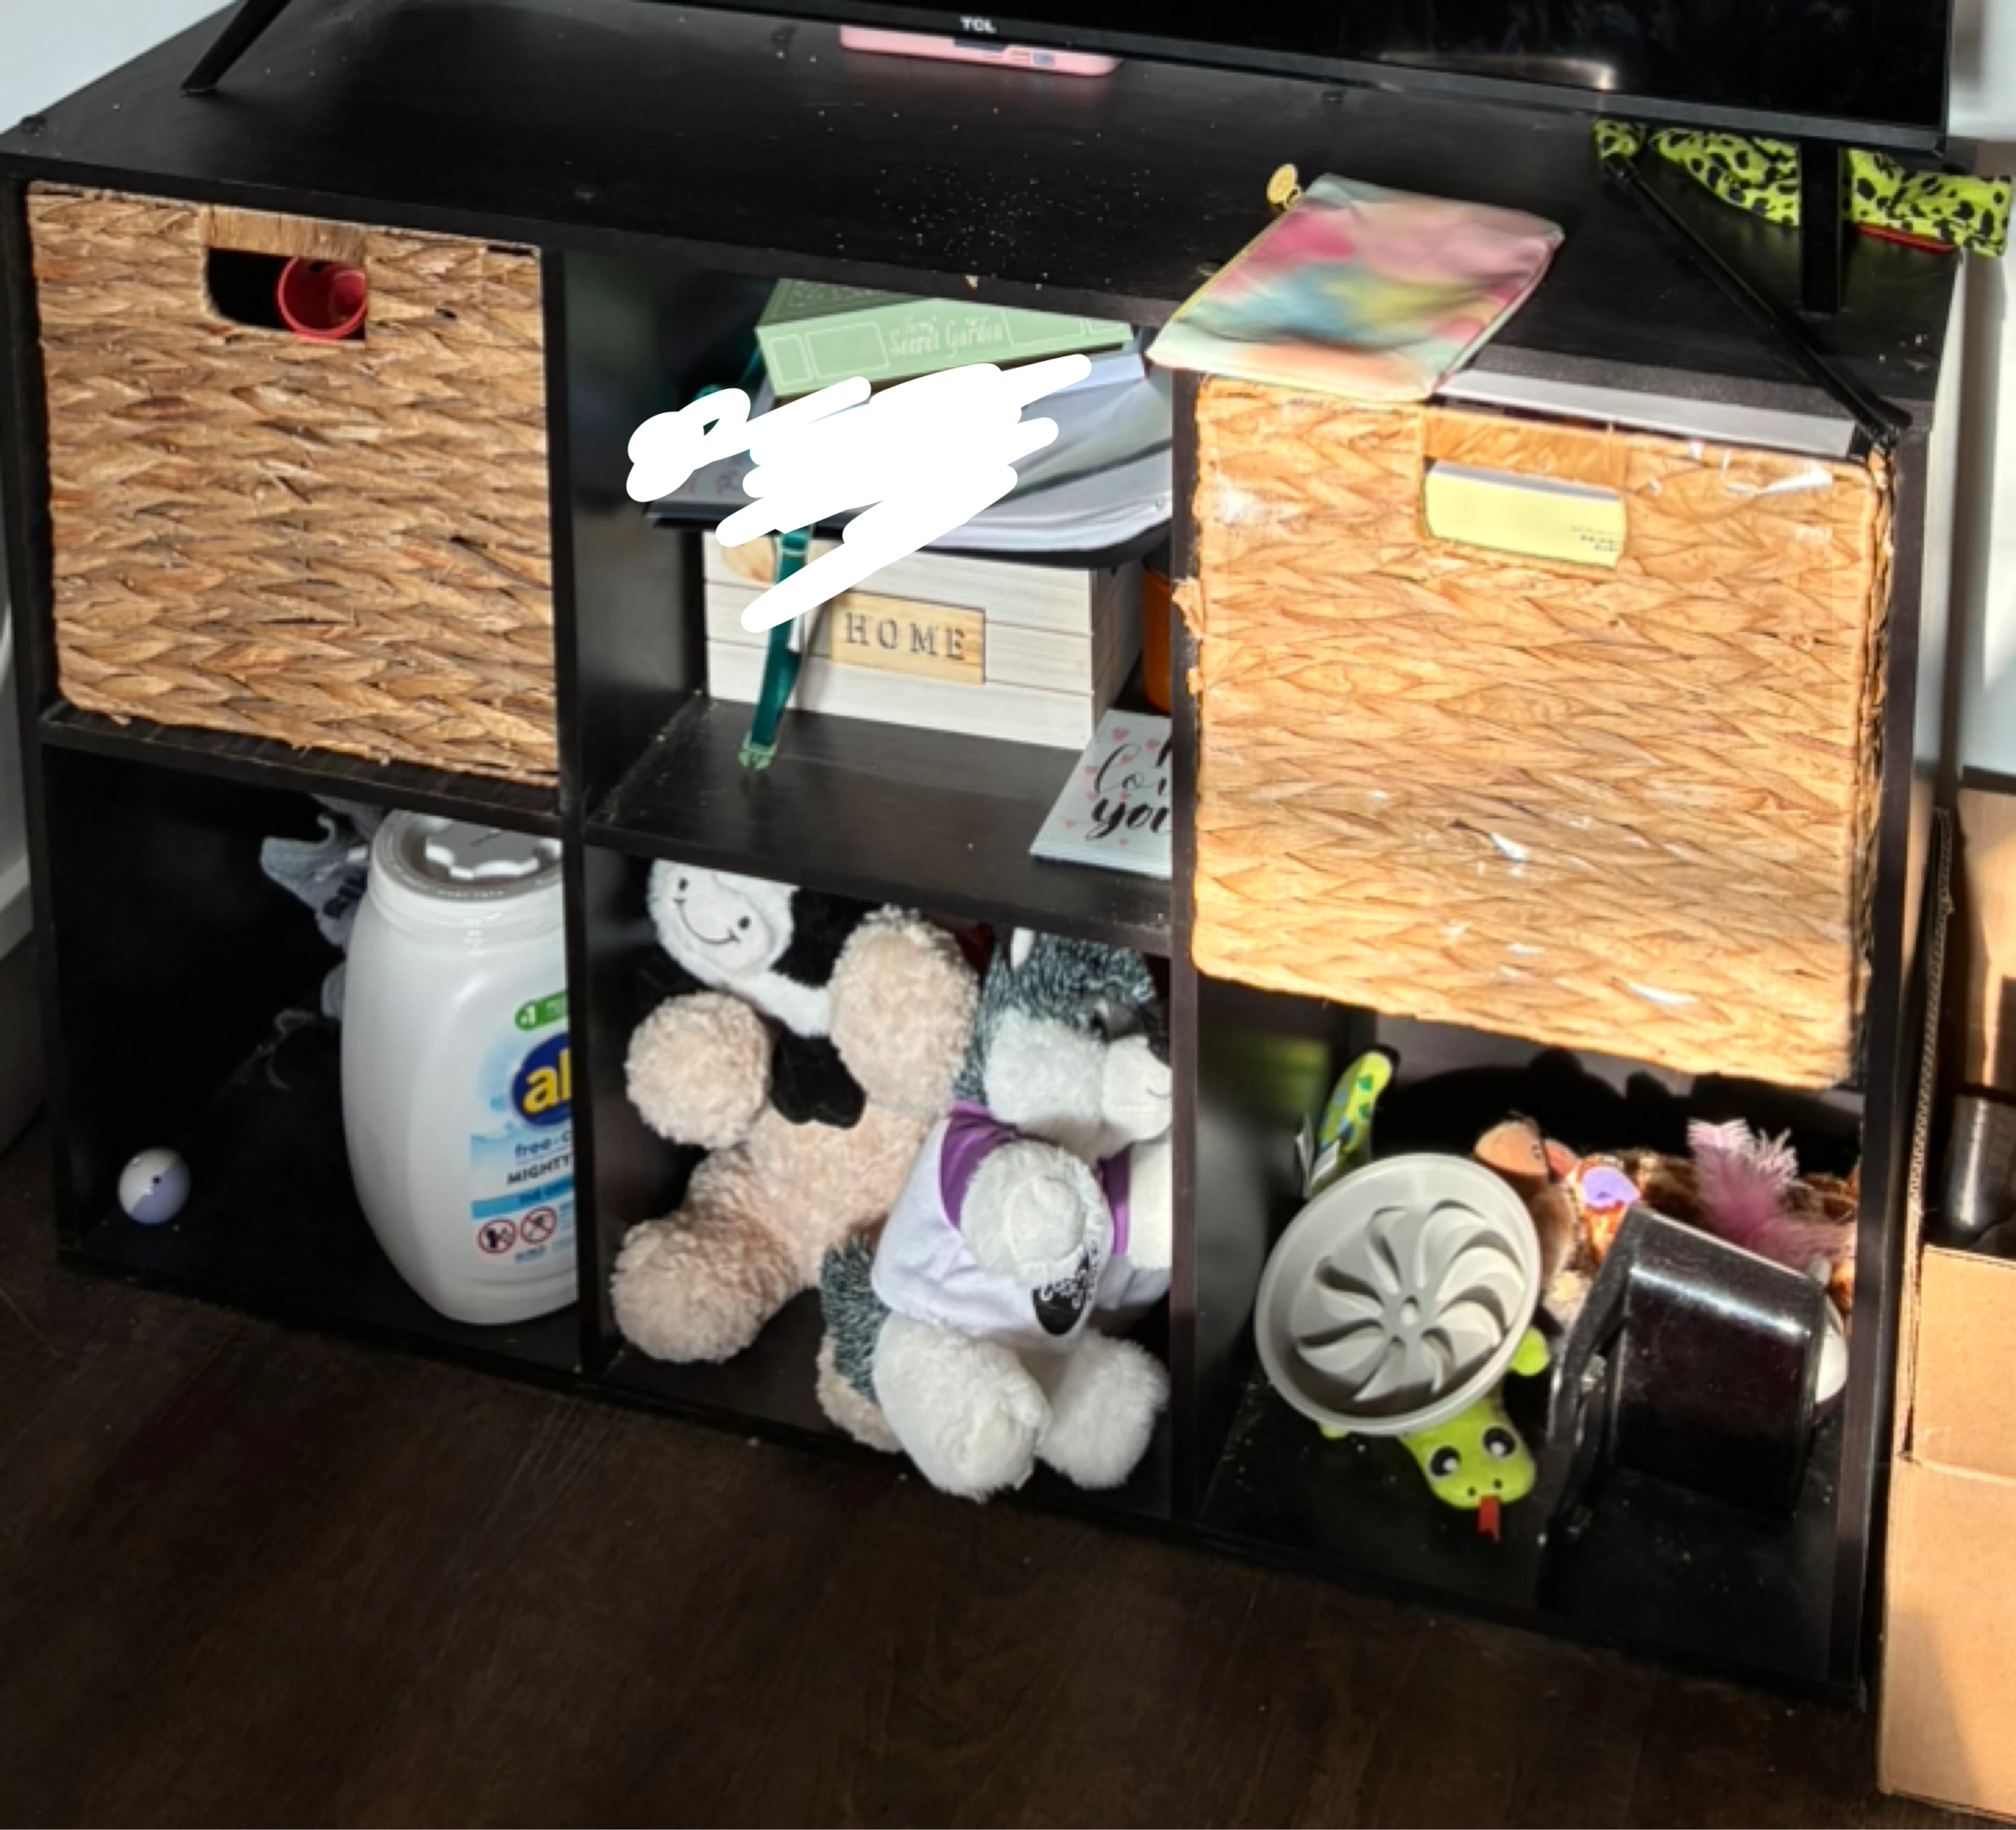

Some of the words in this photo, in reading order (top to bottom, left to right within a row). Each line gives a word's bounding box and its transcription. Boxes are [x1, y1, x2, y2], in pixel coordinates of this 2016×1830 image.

[960, 16, 997, 34] TCL
[889, 327, 942, 356] Secret
[946, 316, 1002, 359] Garden
[846, 612, 966, 660] HOME
[523, 1048, 573, 1115] al
[507, 1155, 569, 1185] MIGHTY
